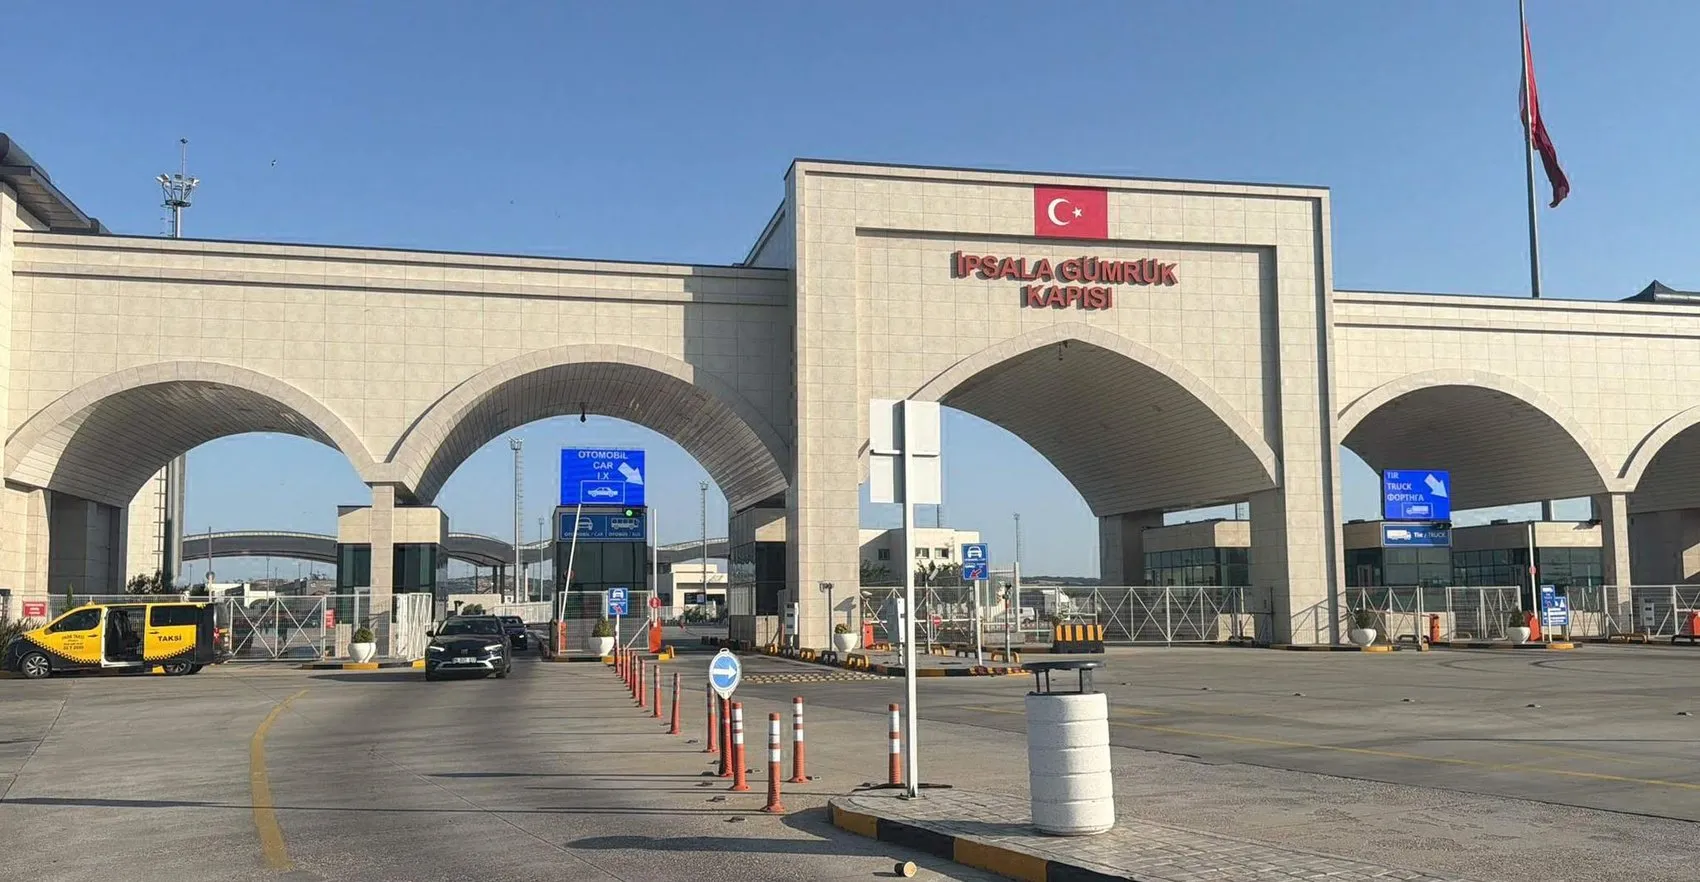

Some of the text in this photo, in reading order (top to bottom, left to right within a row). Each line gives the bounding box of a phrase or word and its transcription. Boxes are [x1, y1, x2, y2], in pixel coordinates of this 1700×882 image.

[954, 250, 1179, 286] İPSALA GÜMRÜK
[1024, 284, 1113, 309] KAPISI
[158, 633, 182, 641] TAKSİ
